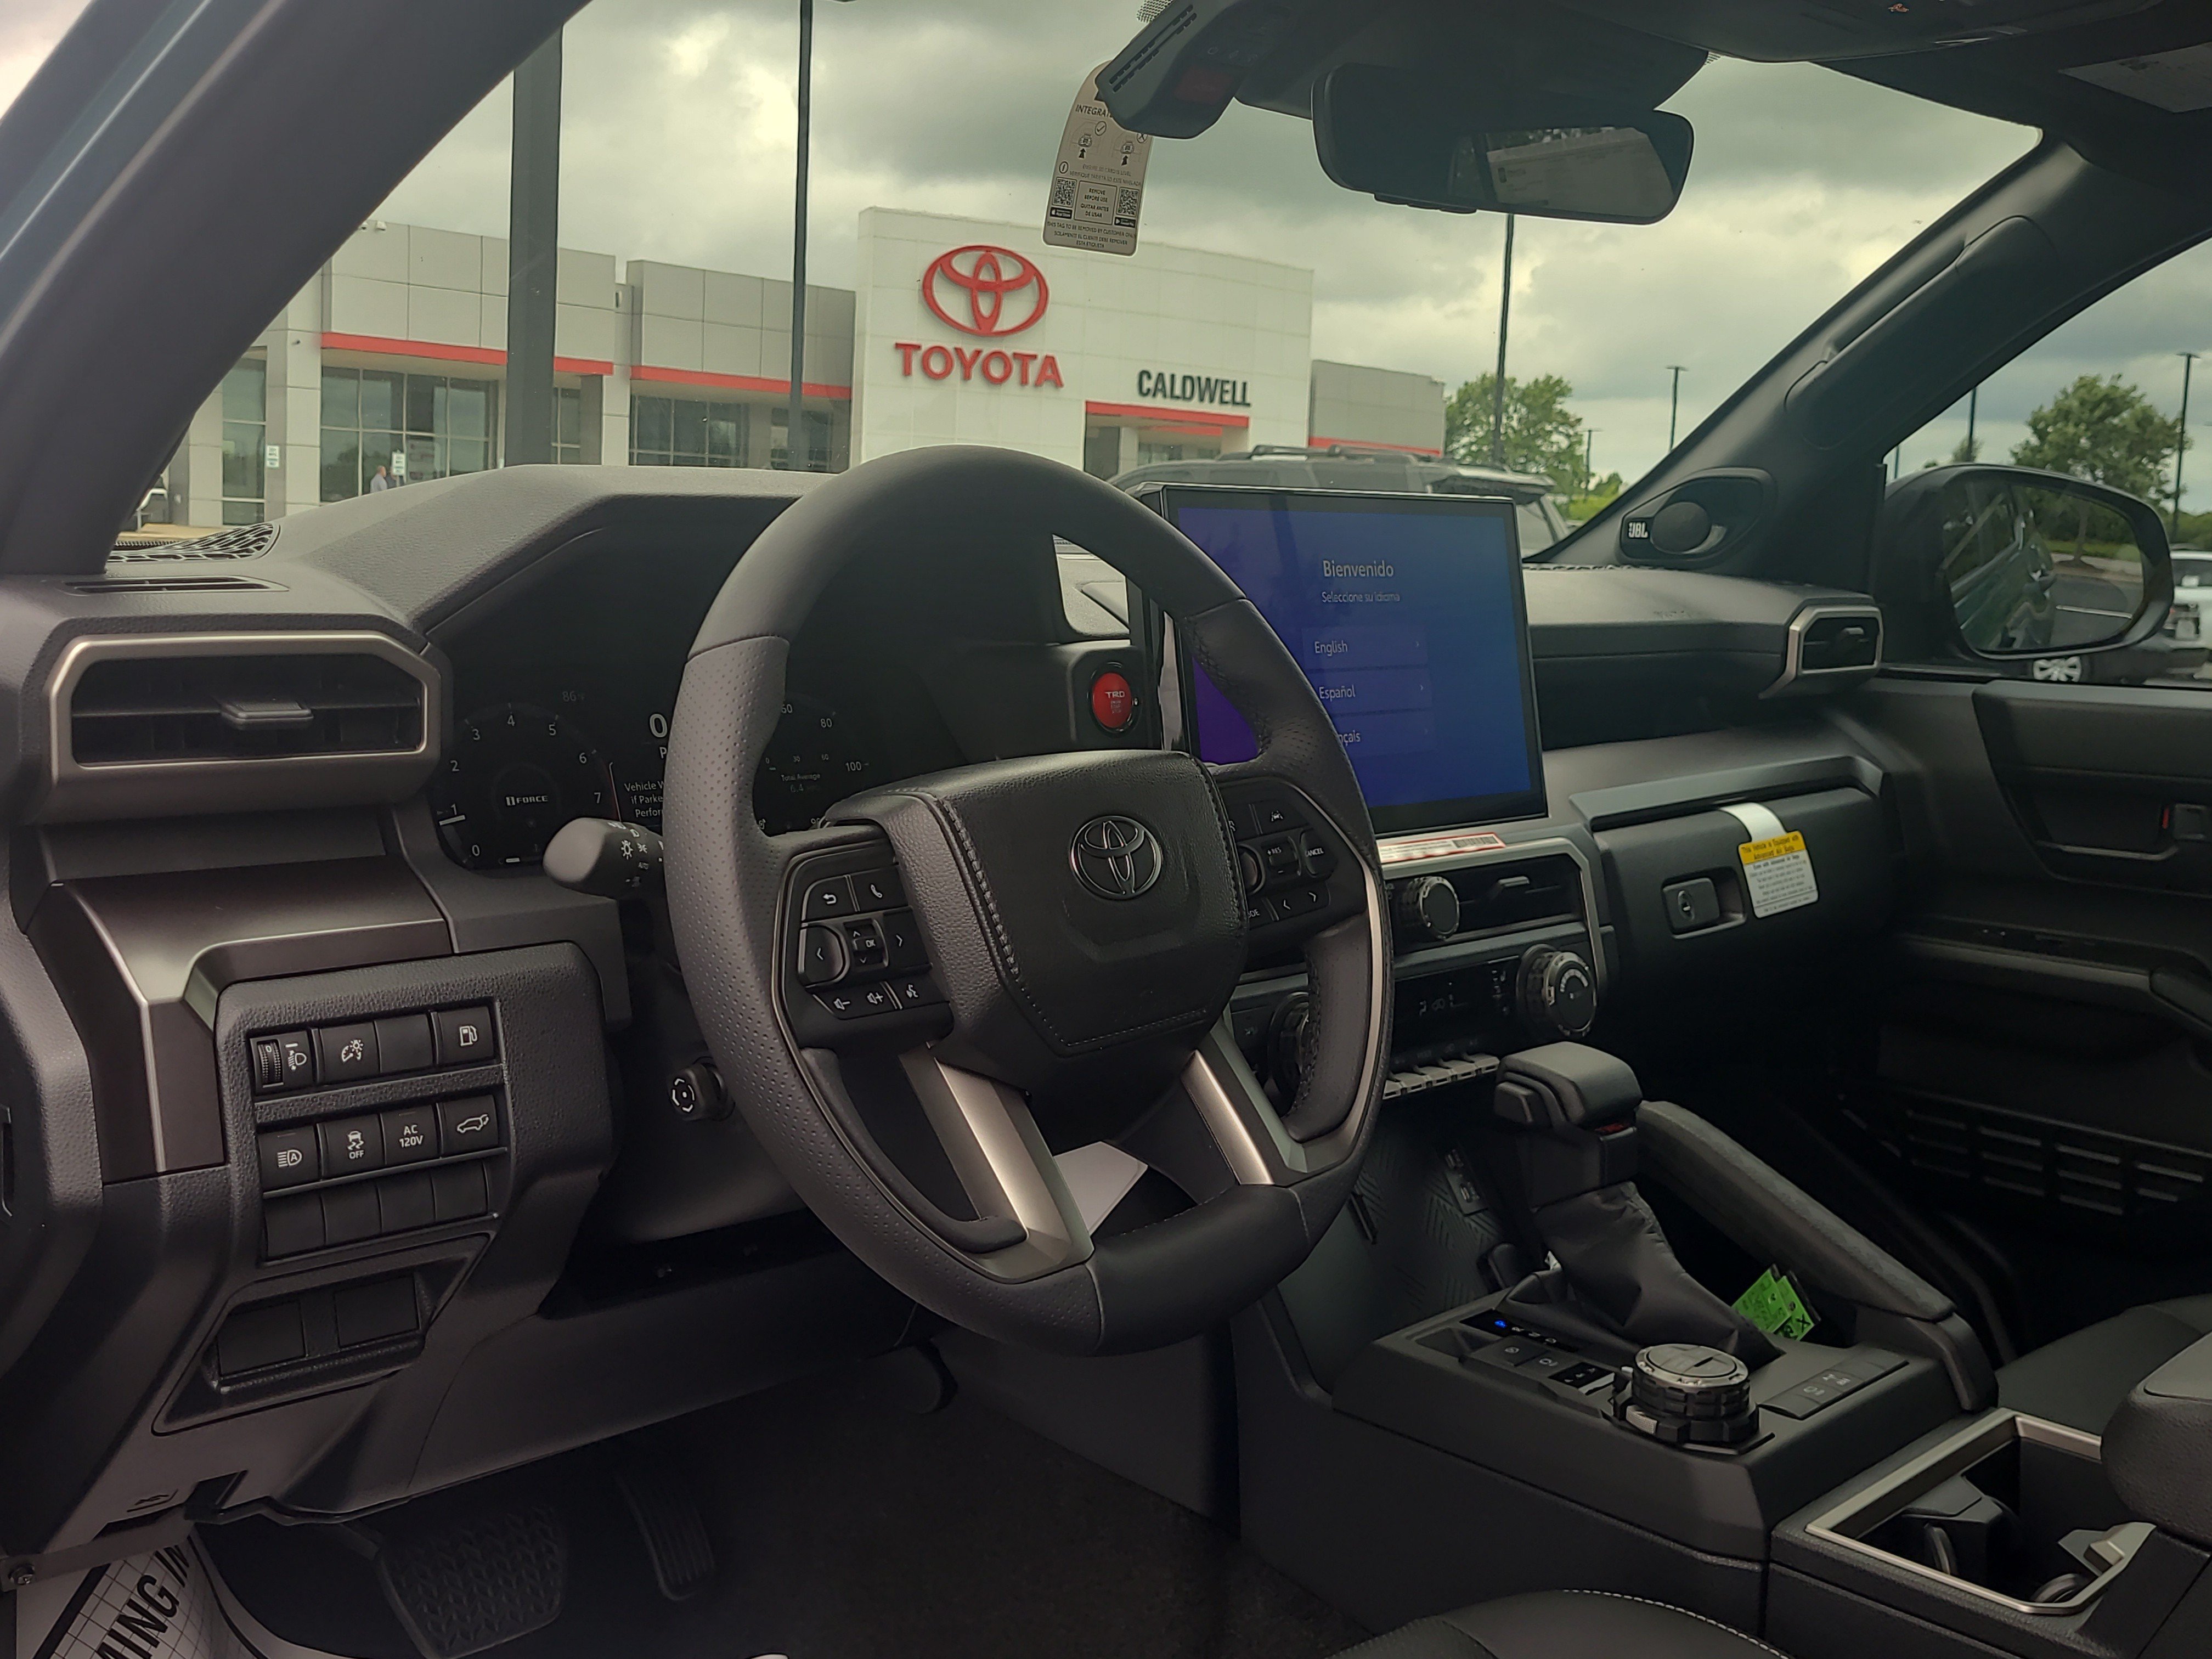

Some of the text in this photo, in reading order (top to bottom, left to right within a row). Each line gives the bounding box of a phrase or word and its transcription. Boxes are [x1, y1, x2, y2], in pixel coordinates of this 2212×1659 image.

[895, 342, 1064, 388] TOYOTA
[1137, 369, 1251, 408] CALDWELL
[1629, 522, 1648, 538] JBL
[1323, 560, 1394, 577] Bienvenido
[1322, 591, 1400, 602] Seleccione su idioma
[1314, 640, 1348, 656] English
[1319, 684, 1356, 702] Español
[507, 714, 516, 727] 4
[649, 713, 668, 738] 0
[820, 718, 832, 729] 80
[472, 729, 481, 741] 3
[549, 724, 557, 736] 5
[579, 752, 588, 764] 6
[450, 760, 460, 772] 2
[845, 761, 862, 772] 100
[624, 781, 657, 792] Vehicle
[594, 792, 602, 804] 7
[631, 795, 637, 805] if
[450, 803, 458, 815] 1
[471, 844, 481, 856] 0
[866, 939, 876, 948] OK
[404, 1125, 418, 1136] AC
[399, 1135, 424, 1148] 120V
[349, 1150, 364, 1159] OFF
